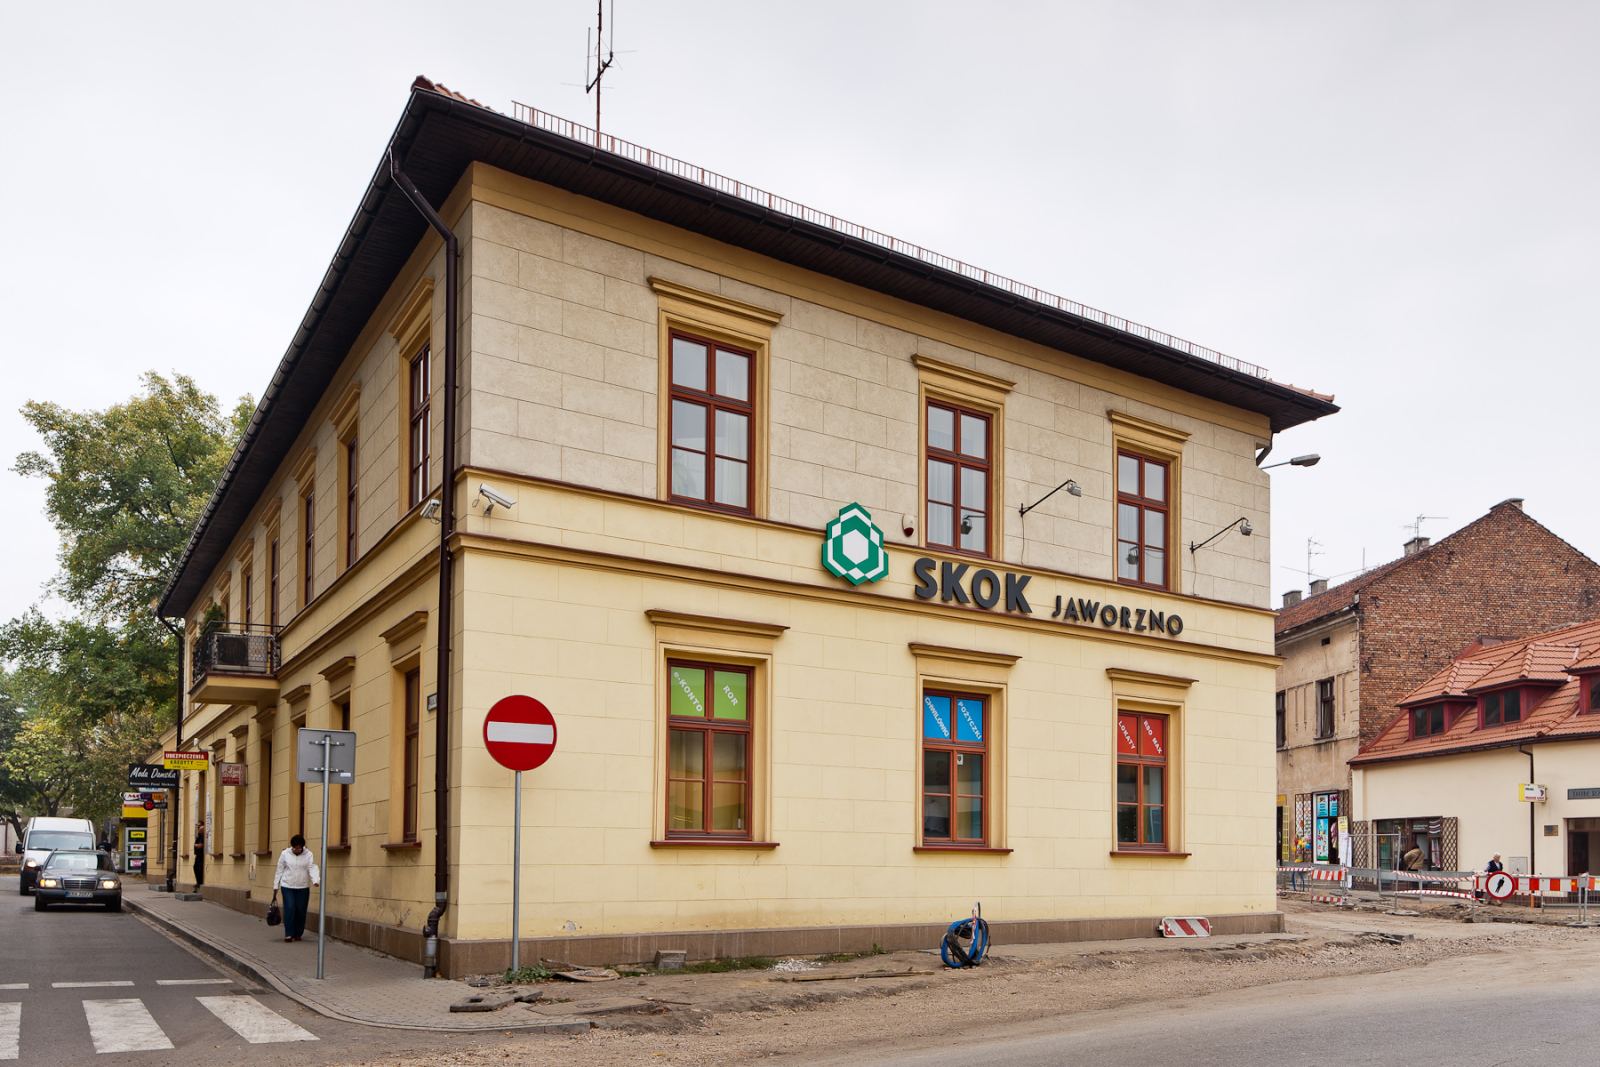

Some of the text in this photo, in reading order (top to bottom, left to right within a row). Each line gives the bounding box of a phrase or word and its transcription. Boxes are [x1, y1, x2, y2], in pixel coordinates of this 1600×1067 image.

[914, 557, 1184, 636] SKOK JAWORZNO
[723, 685, 738, 706] ROR
[1119, 721, 1136, 749] LOKATY
[130, 767, 176, 779] Moda Damska
